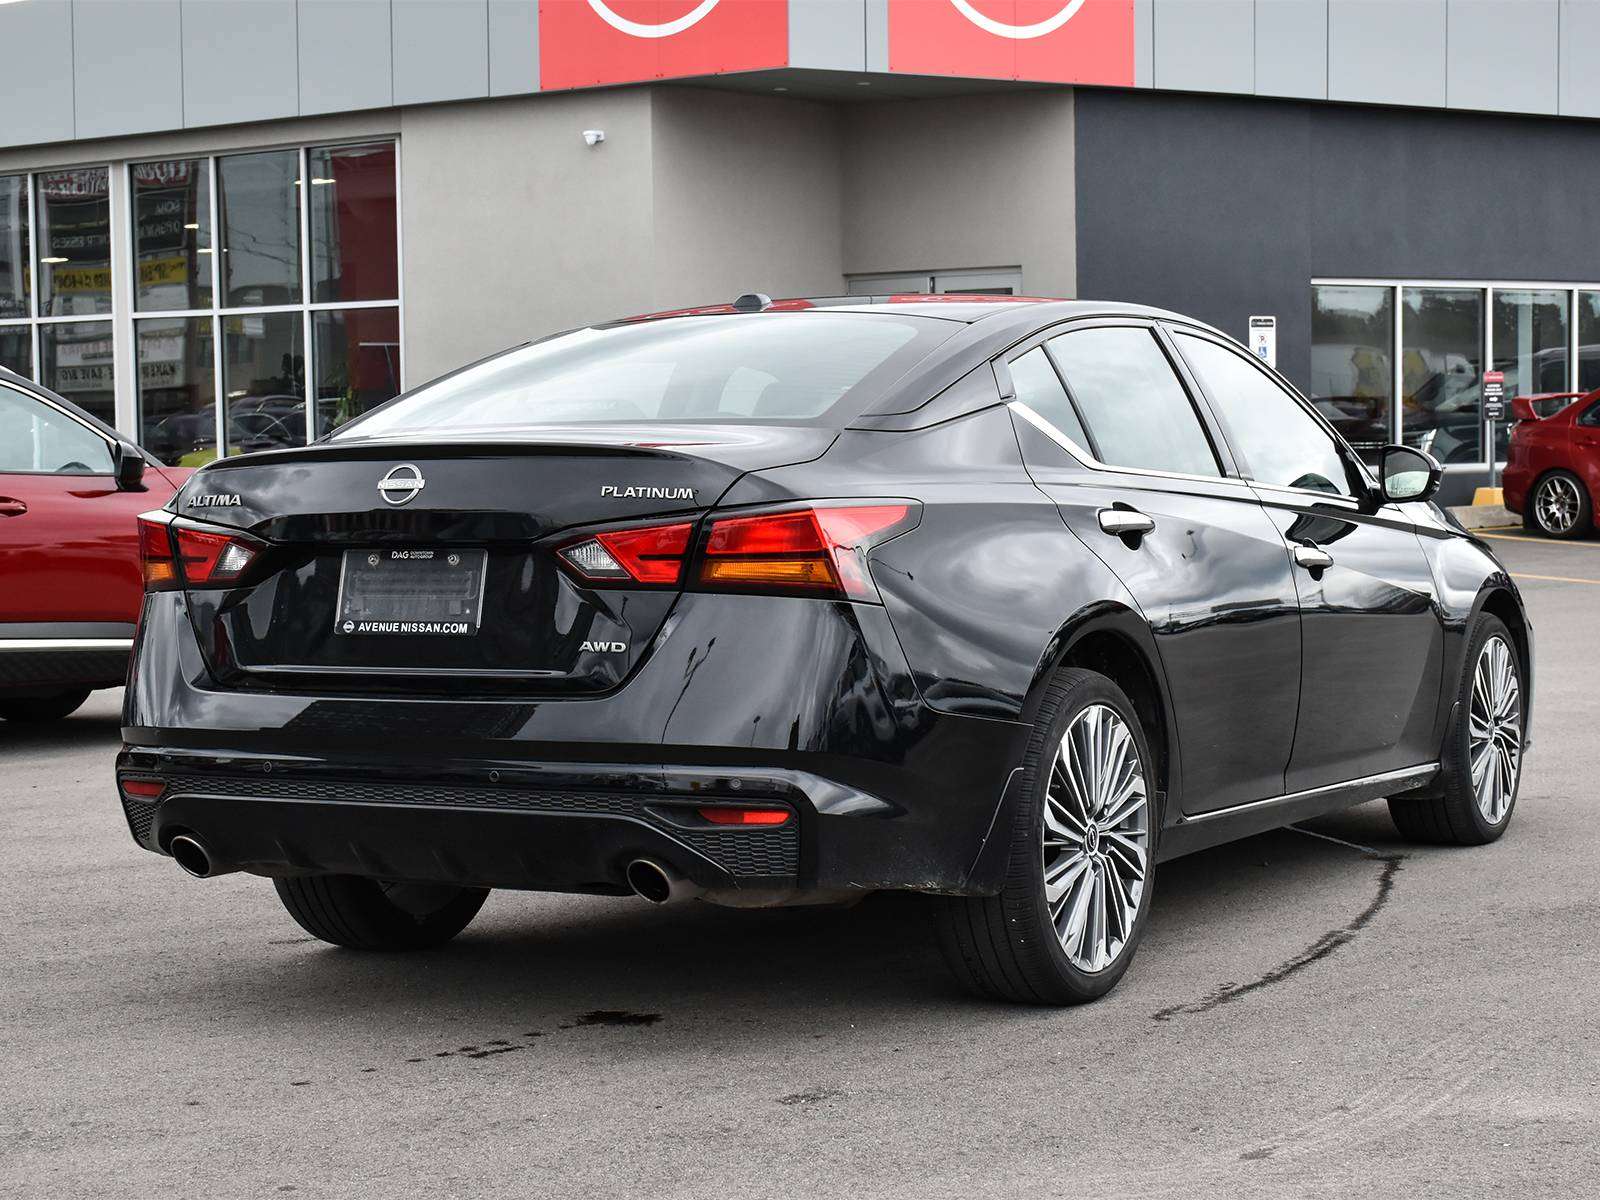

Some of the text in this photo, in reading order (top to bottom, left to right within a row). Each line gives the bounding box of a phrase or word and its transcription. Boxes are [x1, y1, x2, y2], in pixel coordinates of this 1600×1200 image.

[377, 479, 425, 490] NISSAN
[601, 486, 694, 499] PLATINUM
[187, 494, 242, 507] ALTIMA
[391, 550, 409, 559] DAG
[358, 622, 468, 634] AVENUE NISSAN.COM
[578, 641, 627, 653] AWD
